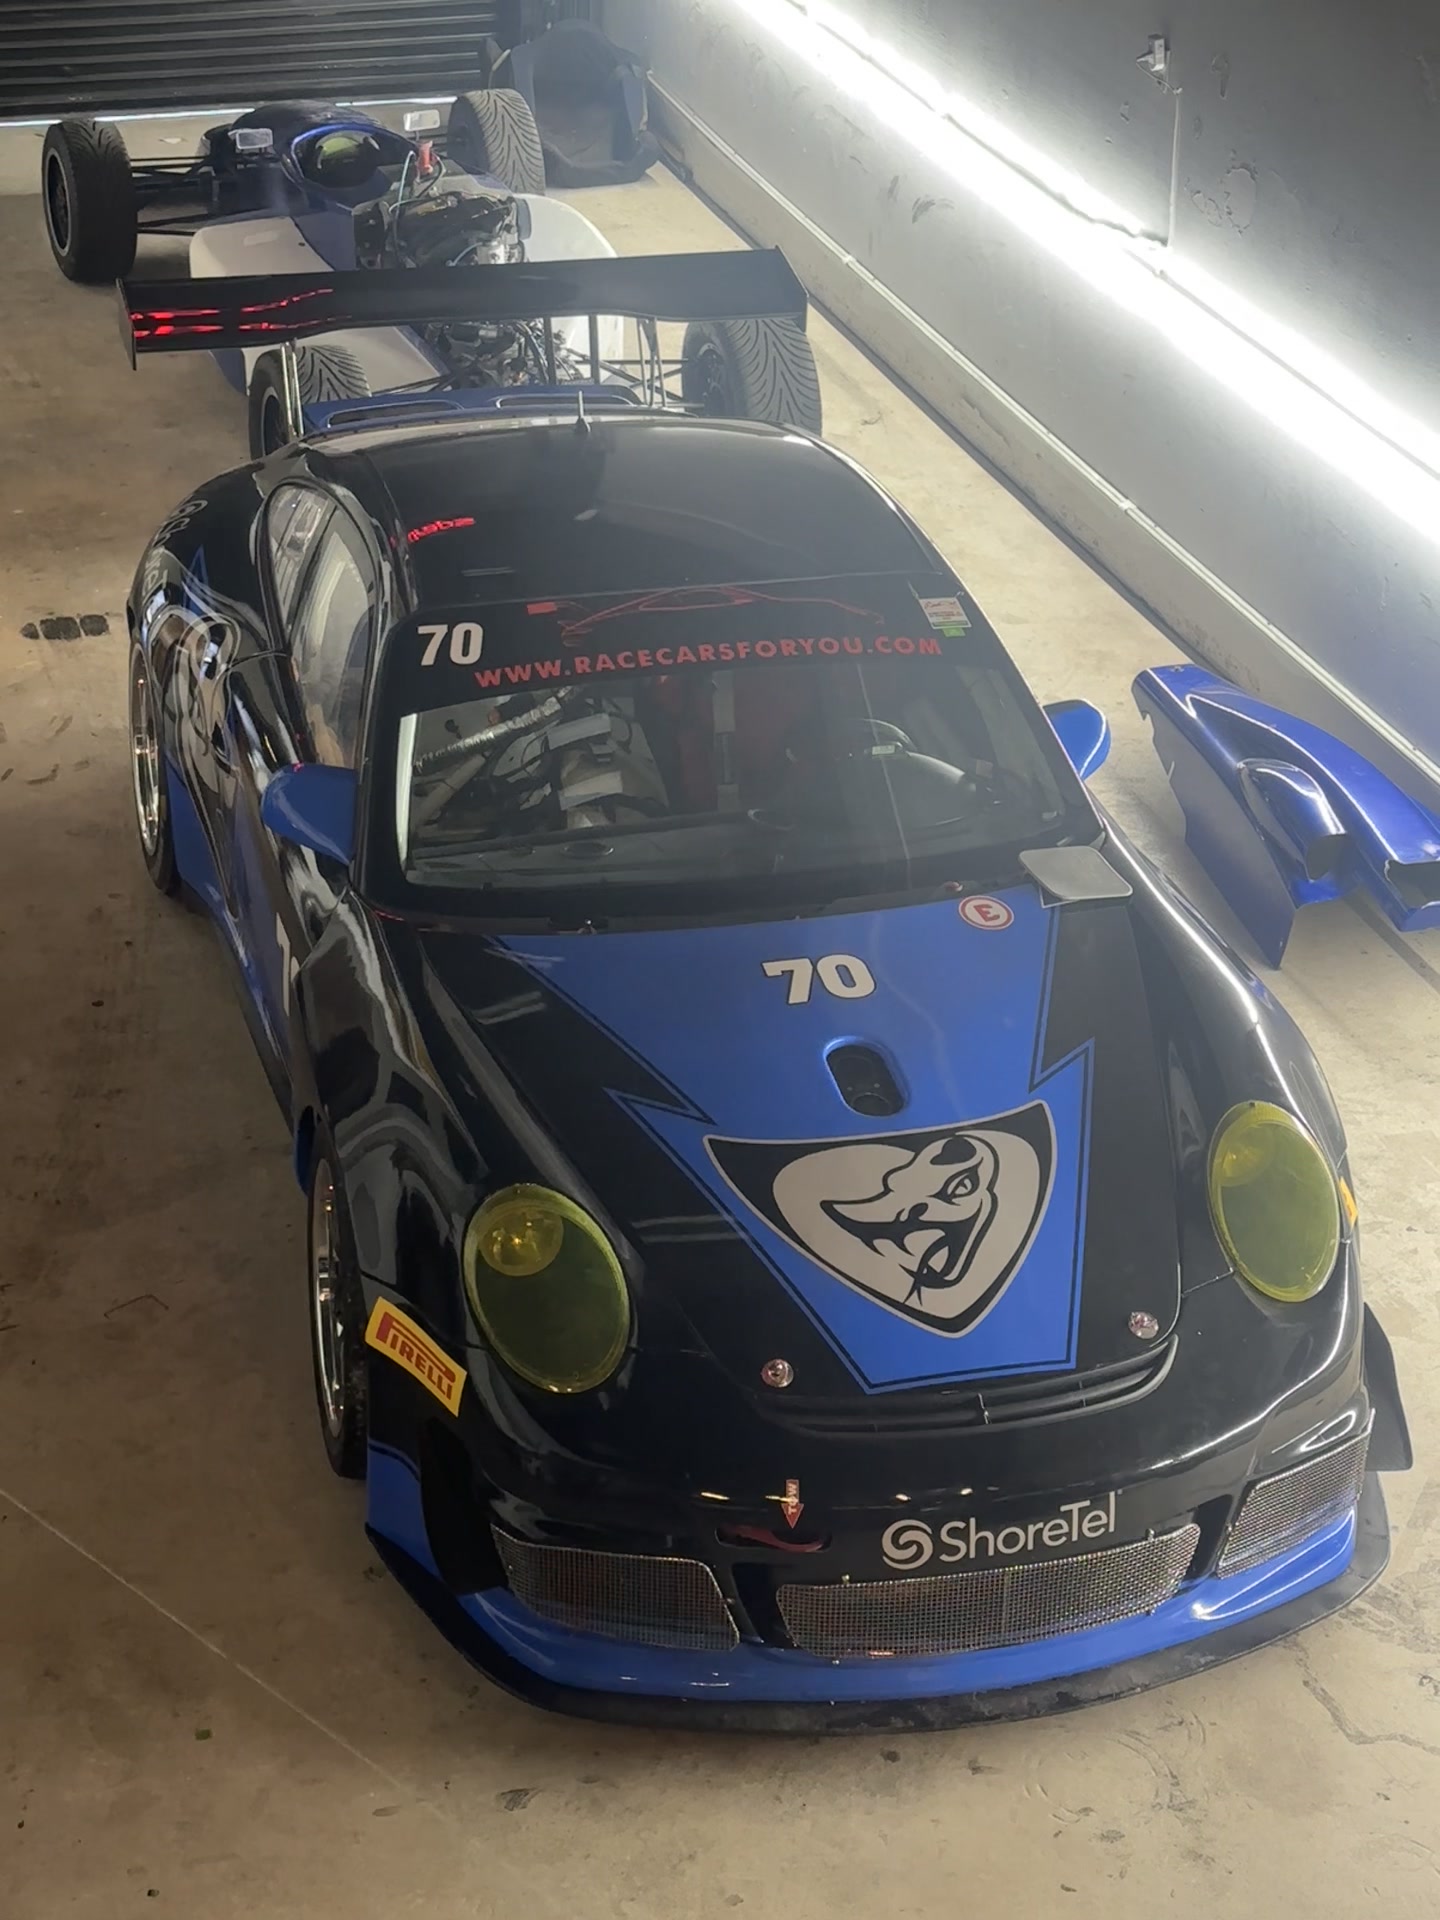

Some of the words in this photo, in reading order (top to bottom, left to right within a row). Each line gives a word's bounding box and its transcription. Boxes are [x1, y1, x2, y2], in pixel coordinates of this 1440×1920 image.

[417, 621, 484, 667] 70
[474, 635, 943, 688] WWW.RACECARSFORYOU.COM
[973, 903, 1000, 923] E
[275, 911, 301, 1017] 7
[761, 953, 877, 1005] 70
[375, 1311, 456, 1401] PIRELLI
[786, 1482, 798, 1516] TOW
[939, 1490, 1116, 1563] ShoreTel
